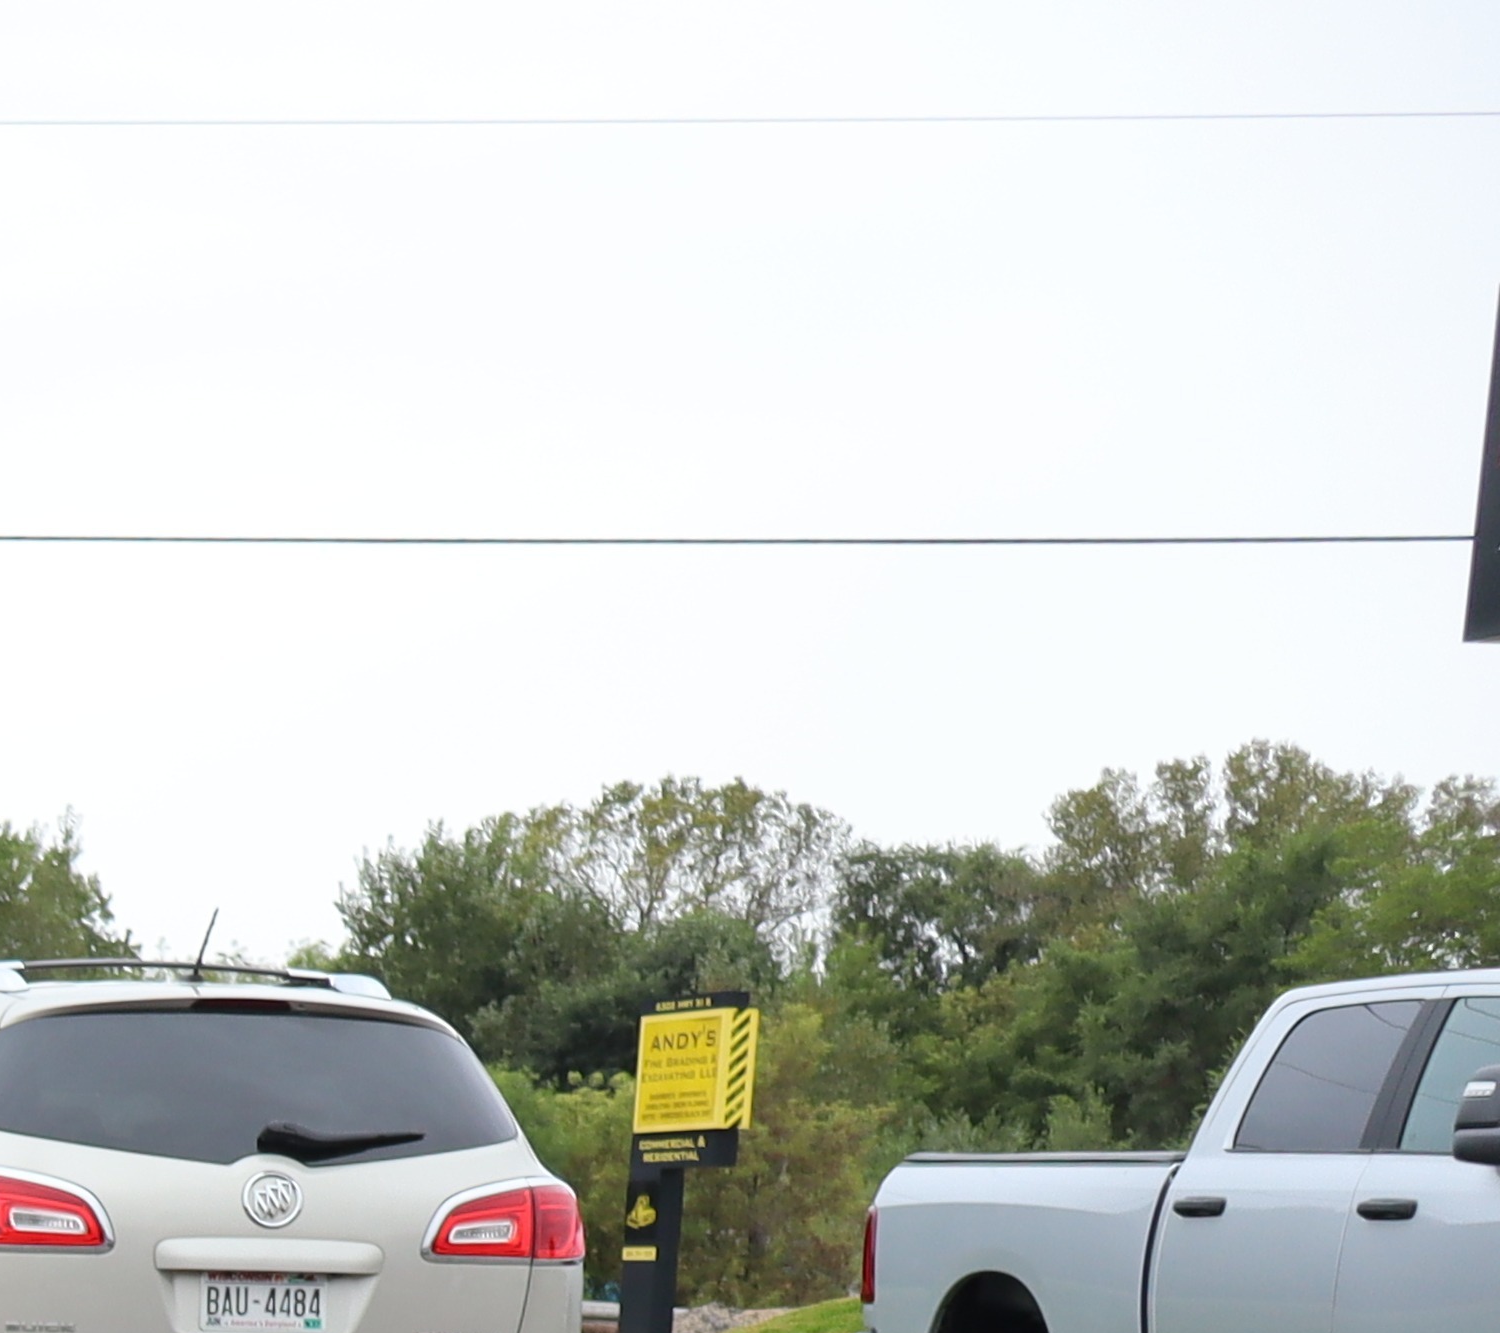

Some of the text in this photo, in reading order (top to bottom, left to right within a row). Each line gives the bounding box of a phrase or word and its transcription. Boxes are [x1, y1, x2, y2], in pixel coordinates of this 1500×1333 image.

[650, 1024, 717, 1053] ANDY'S
[206, 1286, 320, 1318] BAU-4484
[5, 1322, 77, 1333] BUICK
